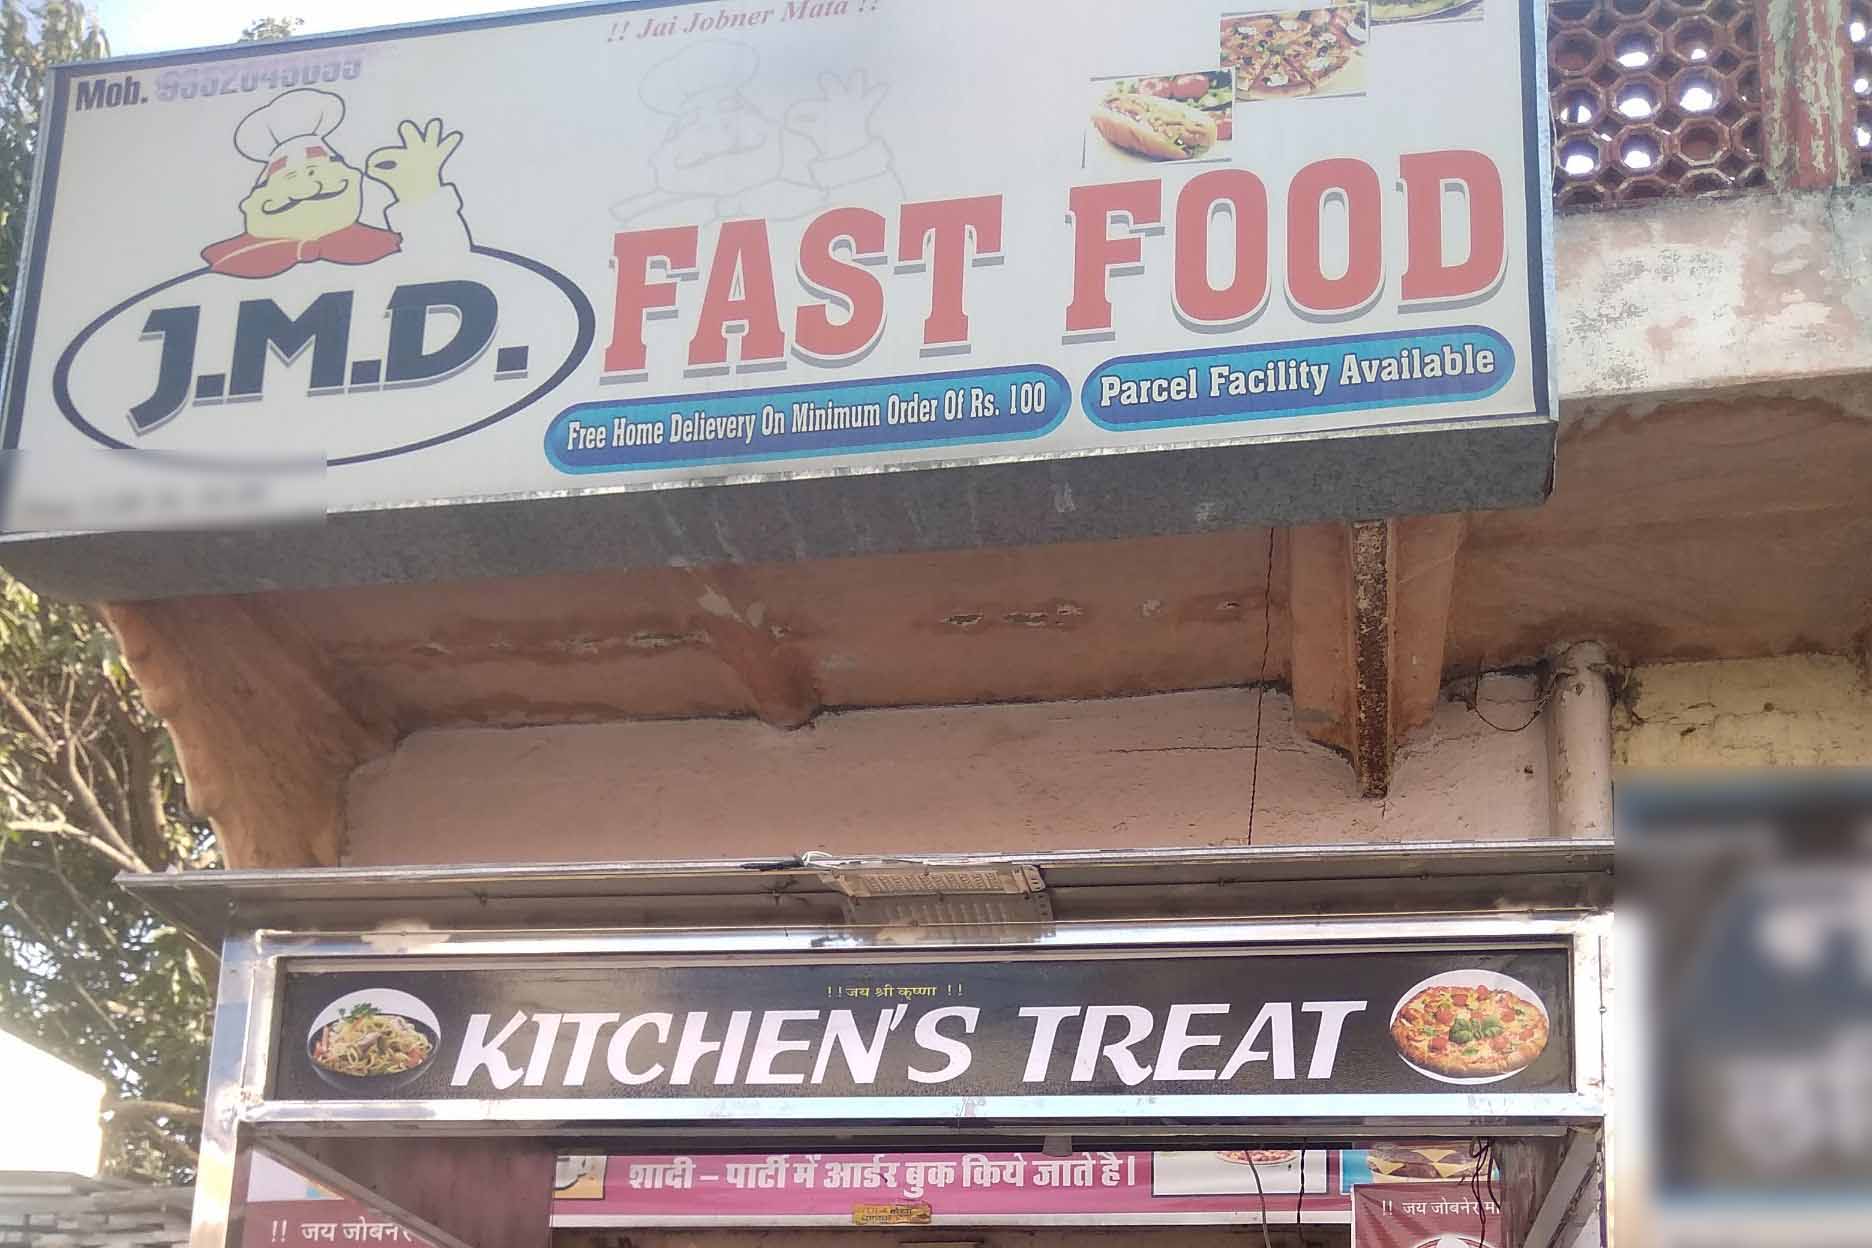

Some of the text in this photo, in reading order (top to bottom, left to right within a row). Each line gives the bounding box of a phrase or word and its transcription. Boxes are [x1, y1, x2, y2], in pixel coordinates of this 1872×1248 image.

[636, 15, 678, 38] Jai
[683, 8, 774, 33] Jobner
[780, 0, 848, 22] Mata
[75, 75, 148, 112] Mob.
[600, 149, 1509, 386] FAST FOOD
[127, 279, 530, 437] J.M.D.
[1100, 343, 1496, 407] Parcel Facility Available
[567, 381, 1047, 450] Free Home Delievery On Minimum Order Of Rs. 100
[450, 1000, 1368, 1091] KITCHEN'S TREAT
[629, 1156, 696, 1189] शादी
[793, 1154, 821, 1189] में
[903, 1161, 957, 1199] बुक
[962, 1152, 1027, 1188] किये
[1031, 1152, 1096, 1187] जाते
[300, 1222, 338, 1242] जय
[1402, 1202, 1428, 1216] जय
